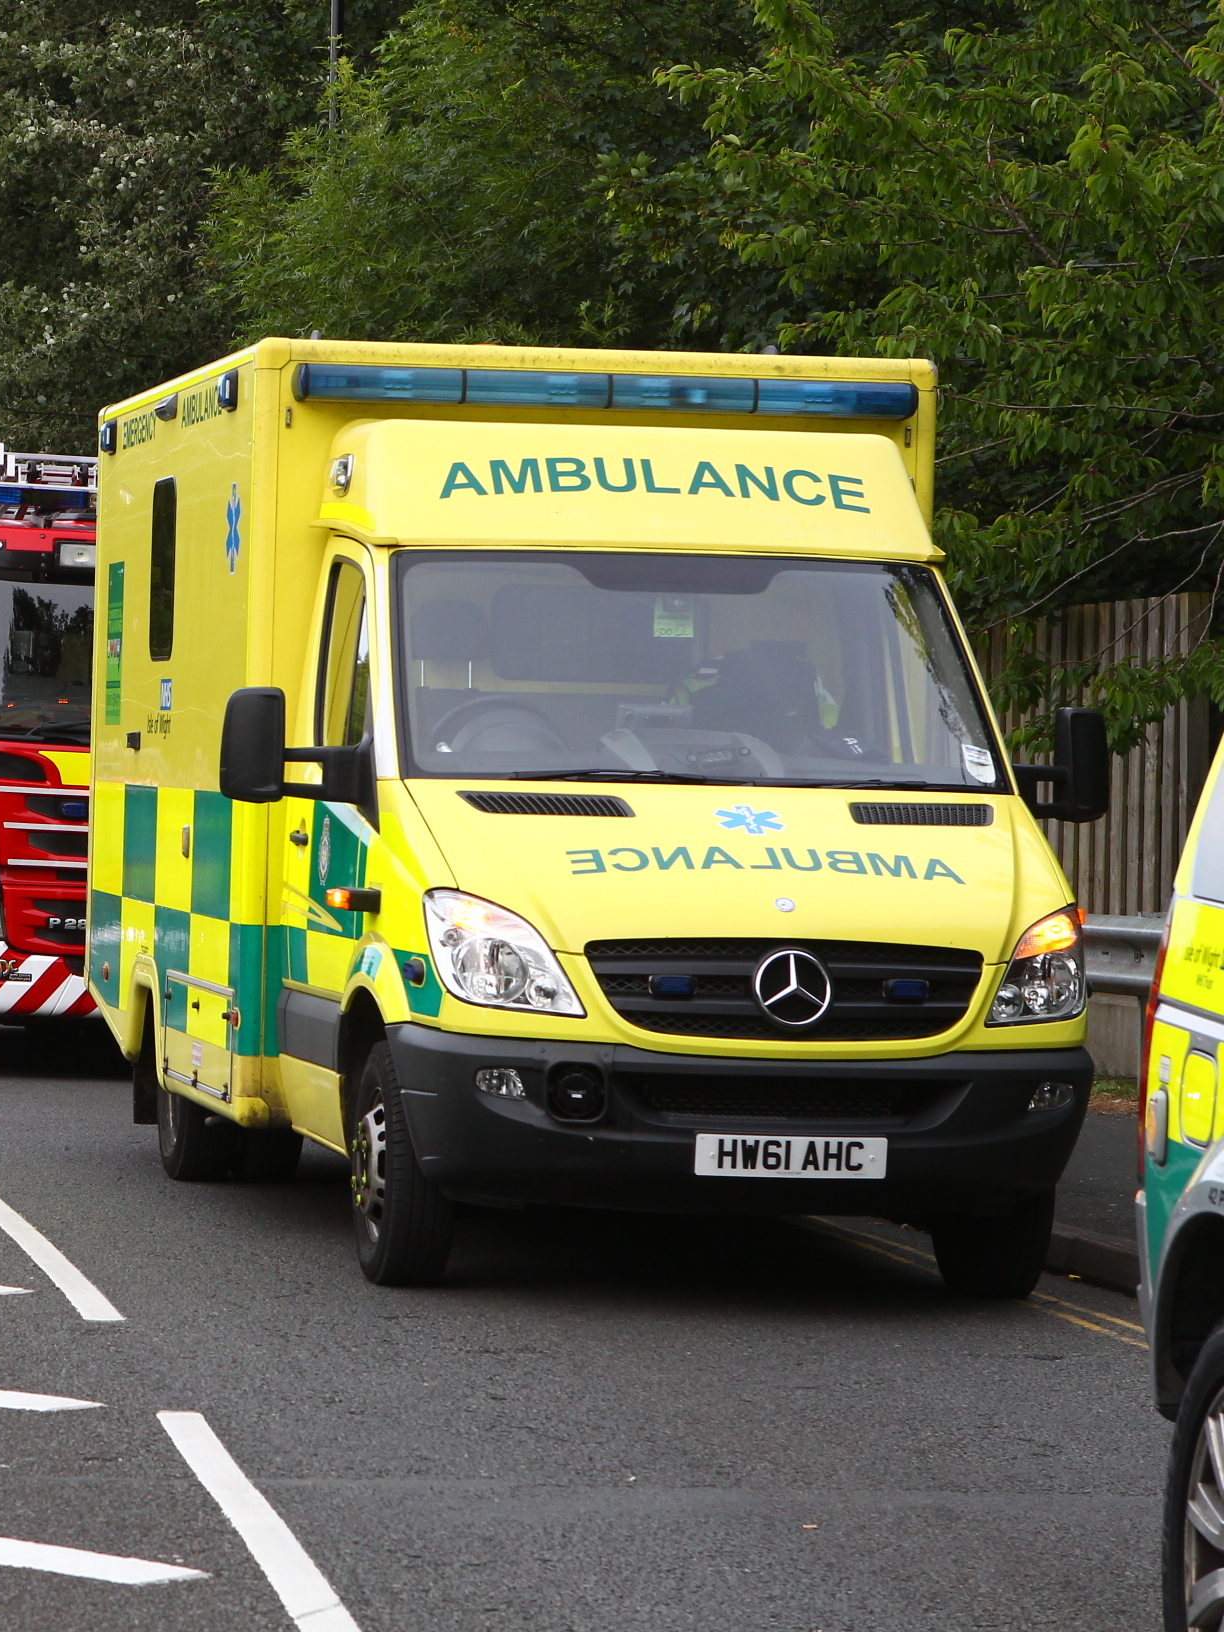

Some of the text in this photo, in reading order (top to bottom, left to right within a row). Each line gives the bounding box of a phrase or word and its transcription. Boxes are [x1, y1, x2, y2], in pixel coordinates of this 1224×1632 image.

[122, 409, 156, 450] EMERGENCY
[439, 456, 872, 514] AMBULANCE
[161, 682, 171, 708] NHS
[154, 712, 159, 734] of
[159, 713, 171, 740] Wight
[49, 917, 86, 930] P 28
[717, 1138, 864, 1172] HW61 AHC
